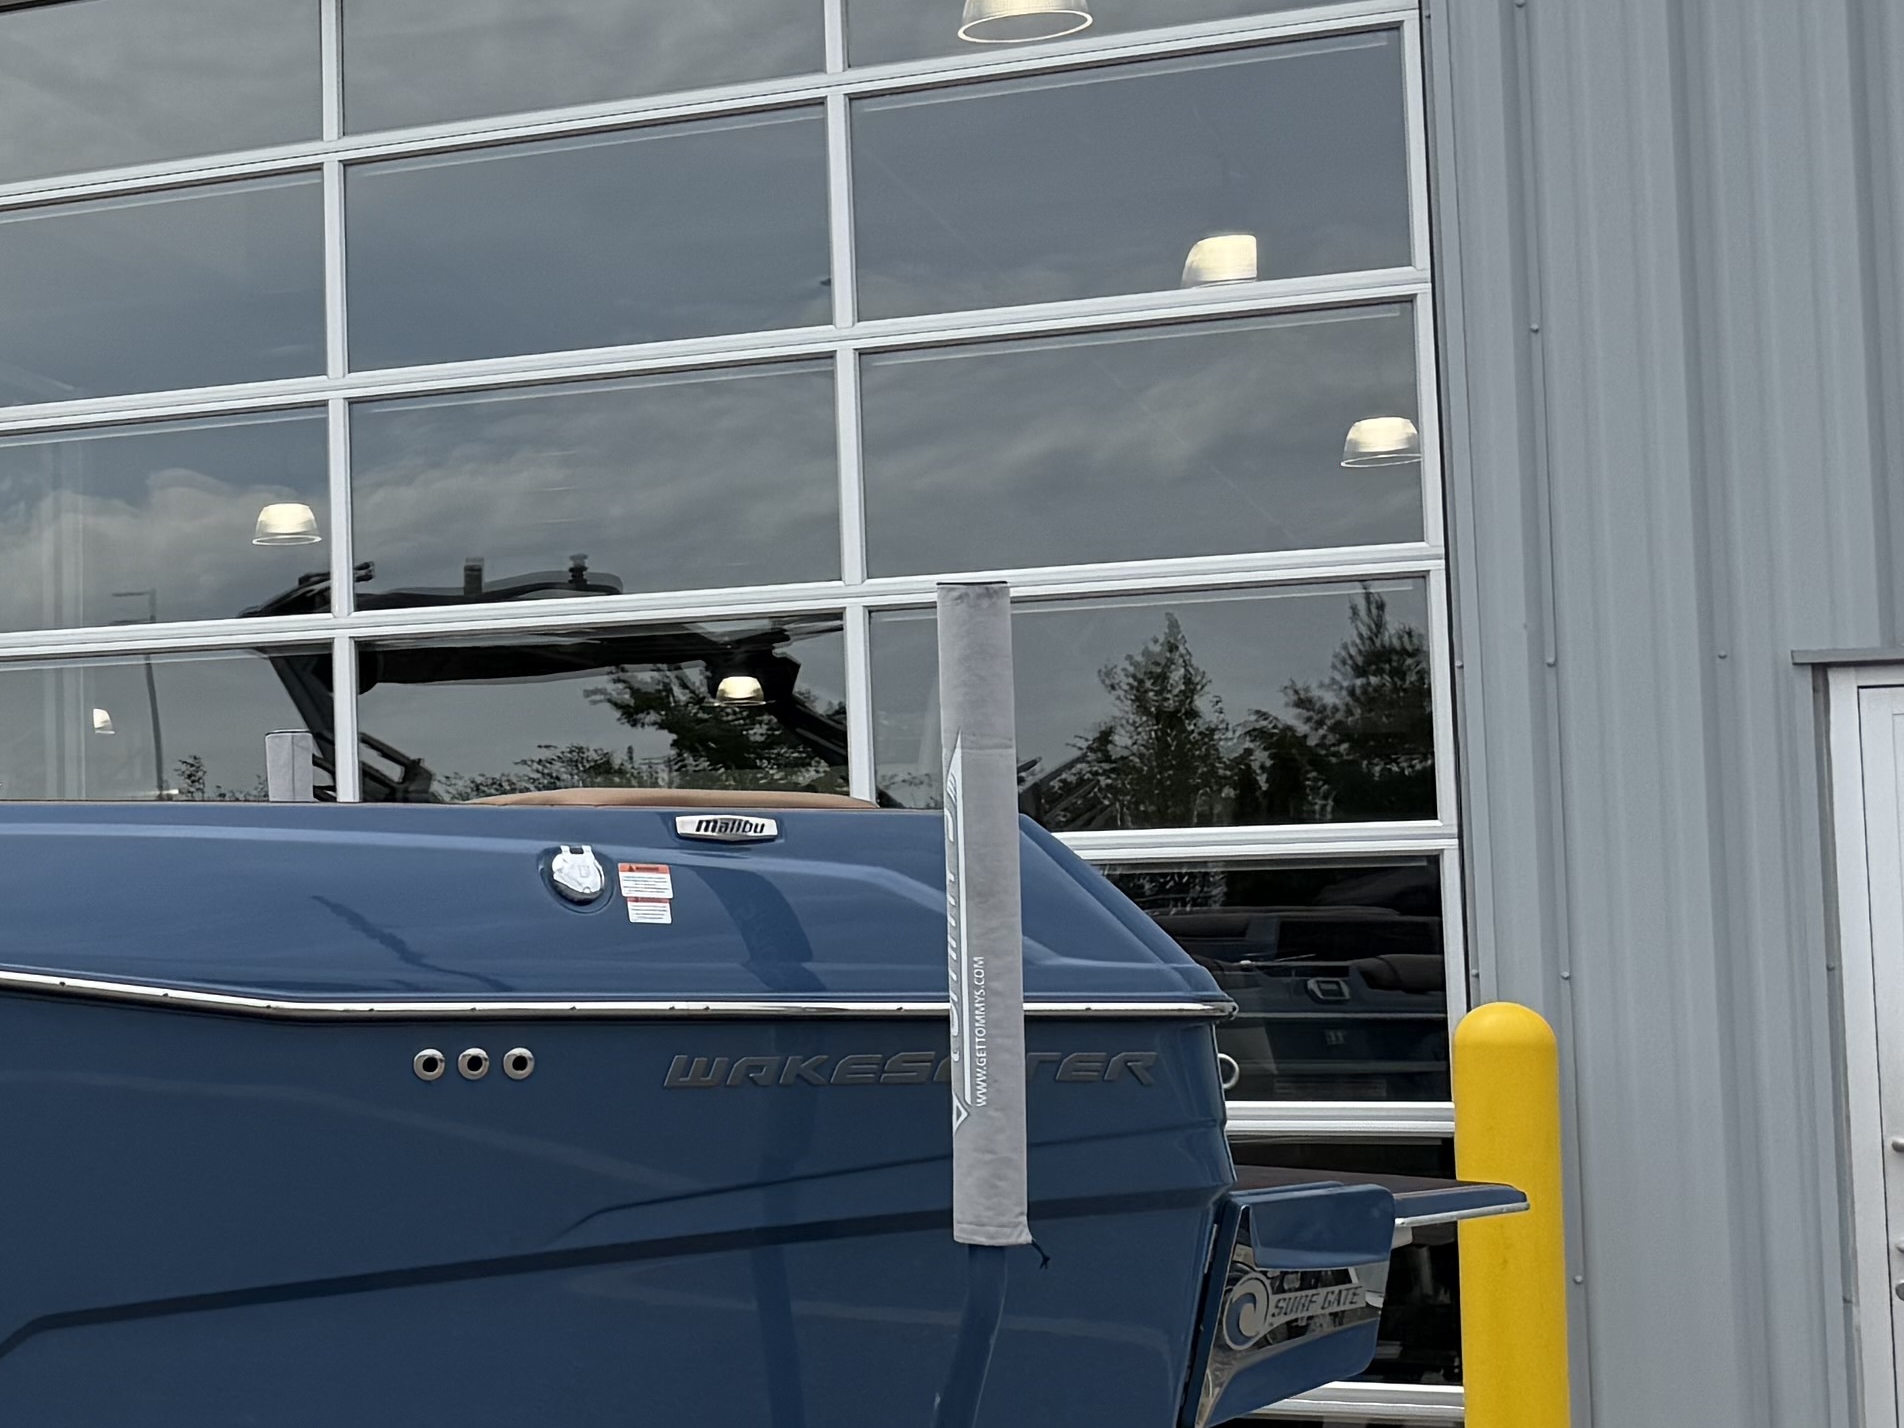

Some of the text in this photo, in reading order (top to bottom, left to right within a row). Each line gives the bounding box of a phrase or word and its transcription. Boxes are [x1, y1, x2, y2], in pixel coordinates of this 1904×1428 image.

[695, 819, 765, 834] Malibu
[972, 956, 987, 1107] WWW.GETTOMMYS.COM
[663, 1051, 1158, 1087] WAKESTER
[1271, 1285, 1363, 1317] SURF GATE
